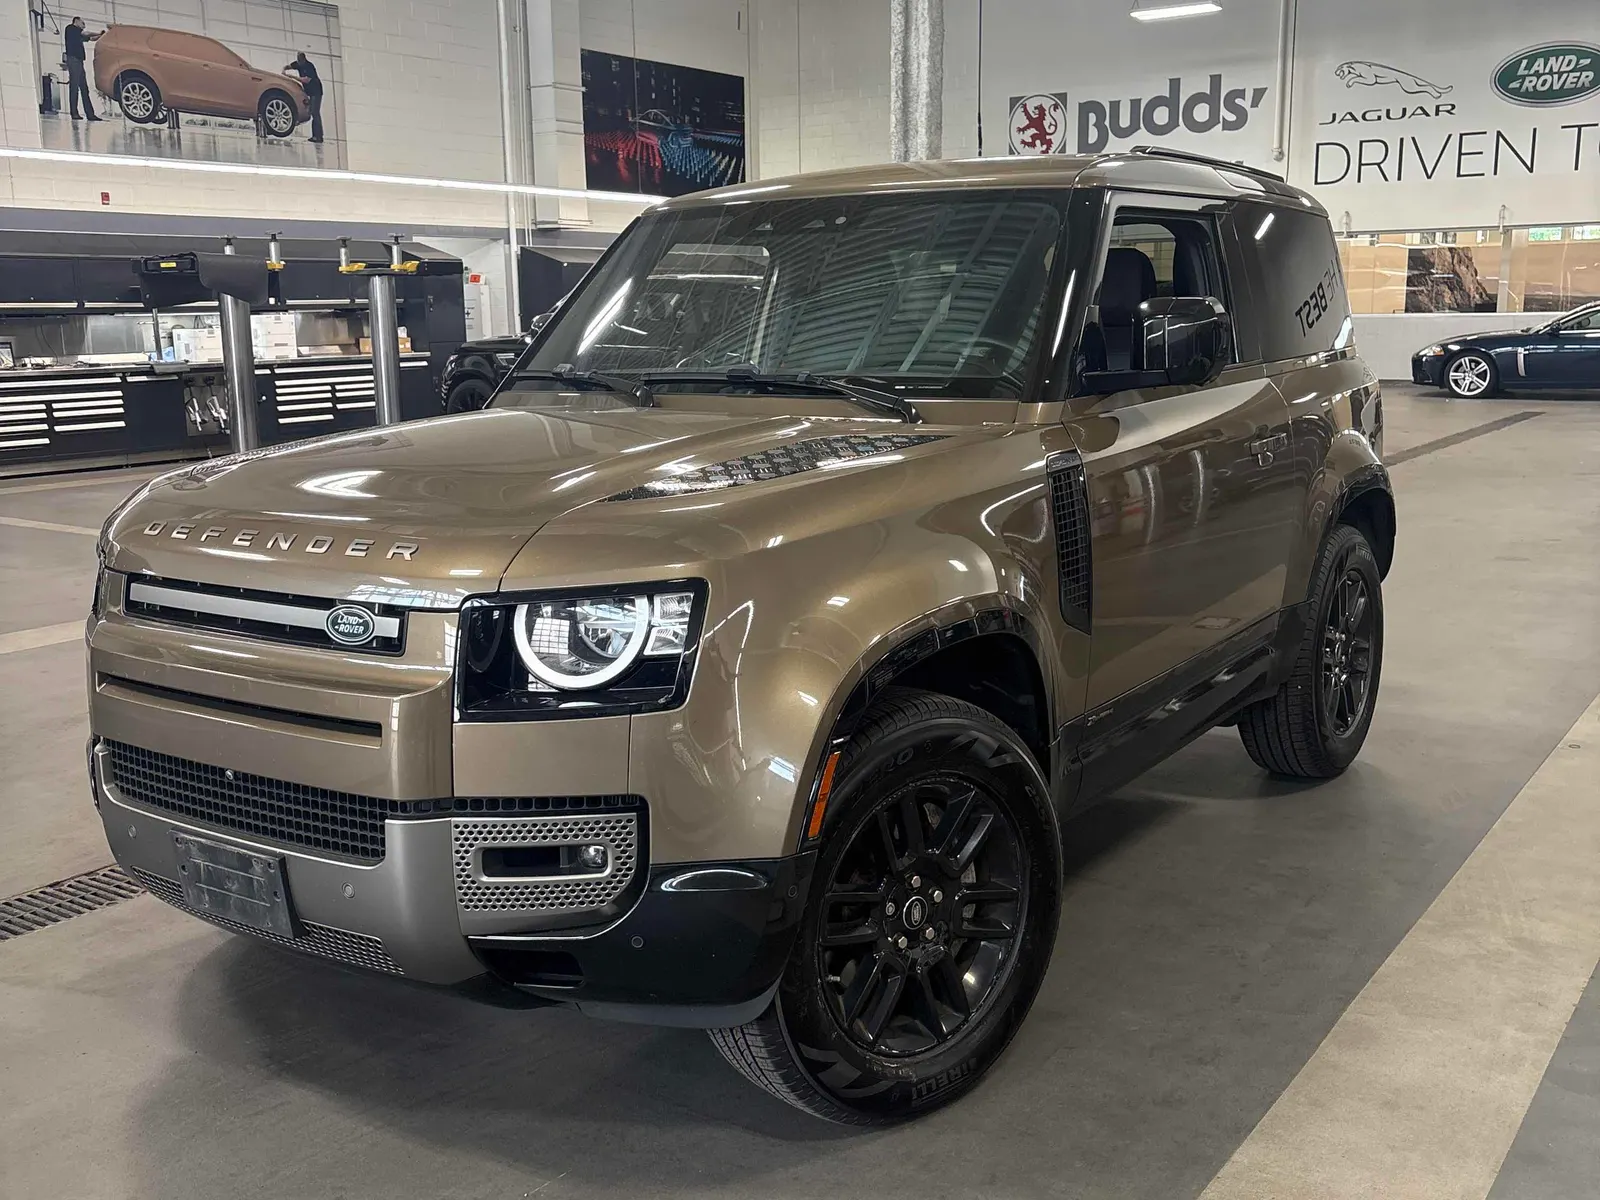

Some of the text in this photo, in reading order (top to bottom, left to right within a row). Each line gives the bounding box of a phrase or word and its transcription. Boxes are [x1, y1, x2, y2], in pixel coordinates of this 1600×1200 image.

[1519, 70, 1595, 93] ROVER
[1318, 102, 1457, 126] JAGUAR
[1314, 122, 1600, 186] DRIVEN T
[142, 520, 420, 562] DEFENDER
[338, 623, 365, 634] ROVER
